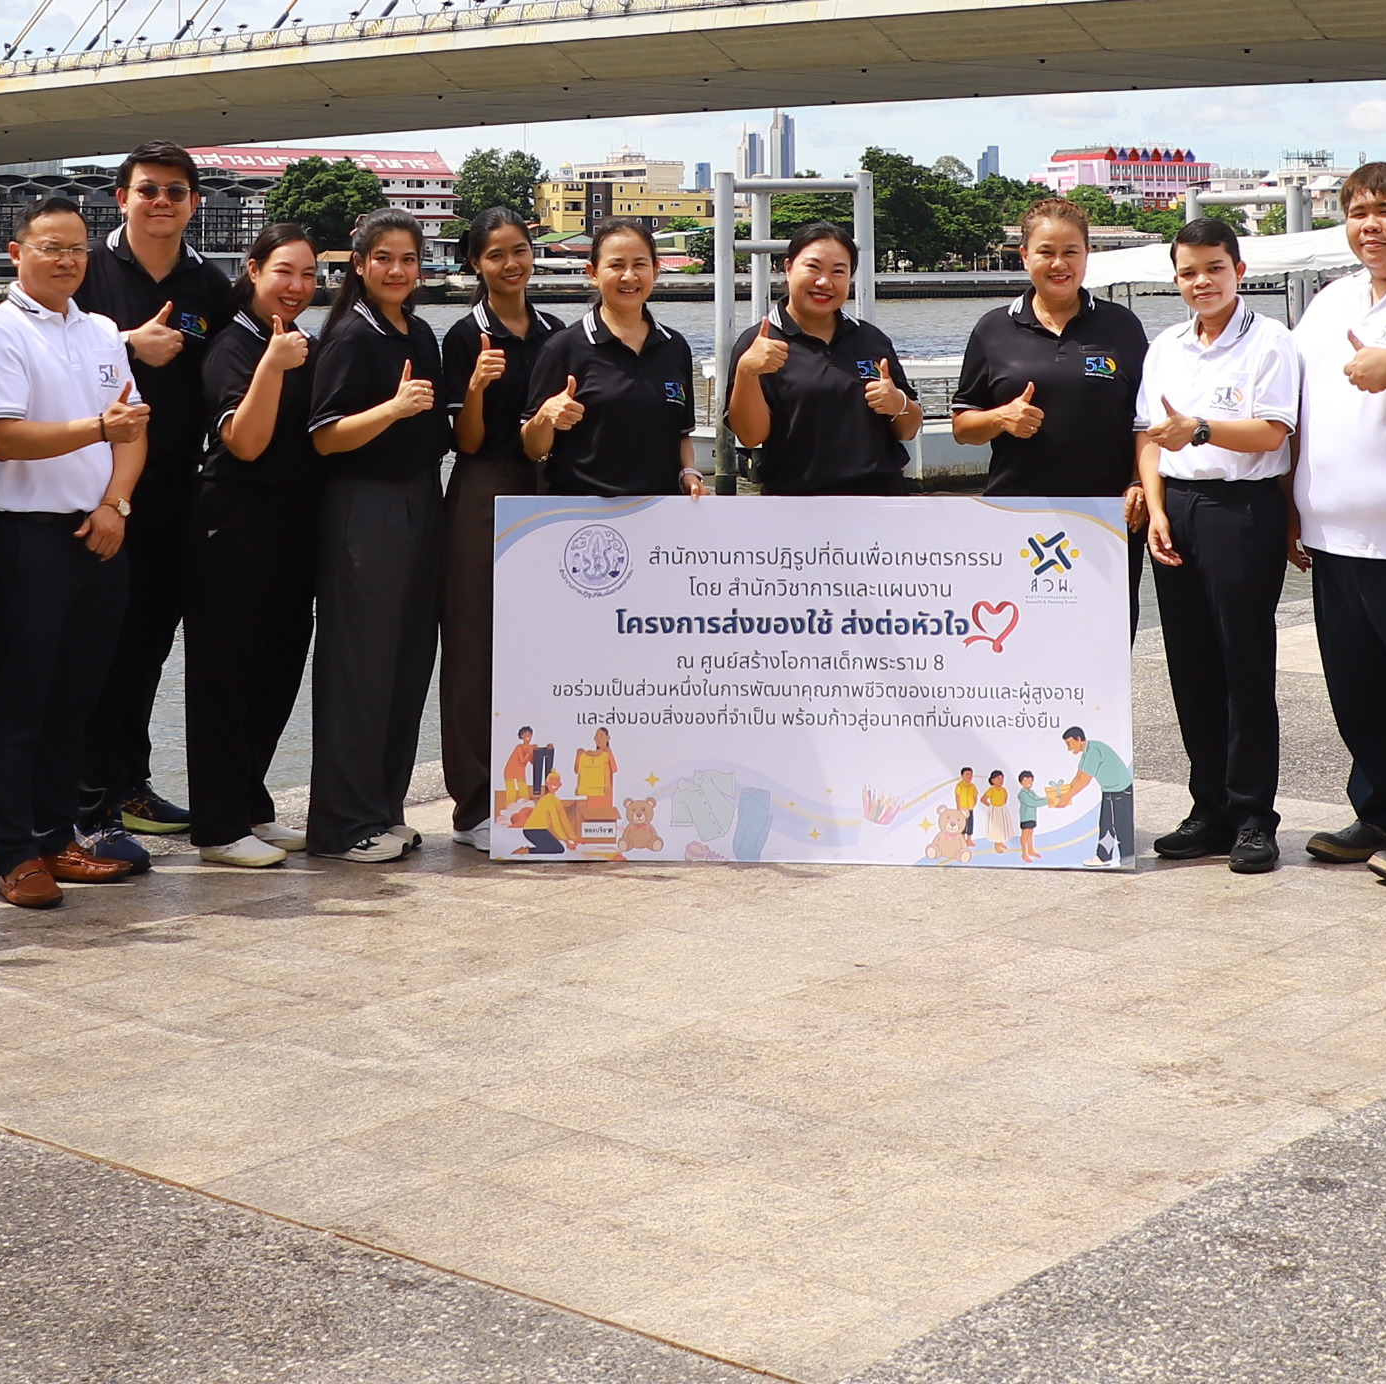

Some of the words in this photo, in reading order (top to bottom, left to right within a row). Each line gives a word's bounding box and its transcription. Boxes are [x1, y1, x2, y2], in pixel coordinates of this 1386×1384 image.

[99, 364, 114, 383] 51
[1086, 356, 1106, 372] 51
[1211, 386, 1232, 405] 51
[648, 541, 1004, 571] สำนักงานการปฏิรูปที่ดินเพื่อเกษตรกรรม
[688, 575, 722, 597] โดย
[727, 576, 953, 598] สำนักวิชาการและแผนงาน
[616, 608, 833, 635] โครงการส่งของใช้
[841, 608, 970, 636] ส่งต่อหัวใจ
[677, 655, 694, 669] ณ
[701, 650, 927, 674] ศูนย์สร้างโอกาสเด็กพระราม
[933, 654, 945, 671] 8
[552, 675, 1085, 705] ขอร่วมเป็นส่วนหนึ่งในการพัฒนาคุณภาพชีวิตของเยาวชนและผู้สูงอายุ
[577, 703, 776, 726] และส่งมอบสิ่งของที่จำเป็น
[782, 707, 1060, 731] พร้อมก้าวสู่อนาคตที่มั่นคงและยั่งยืน
